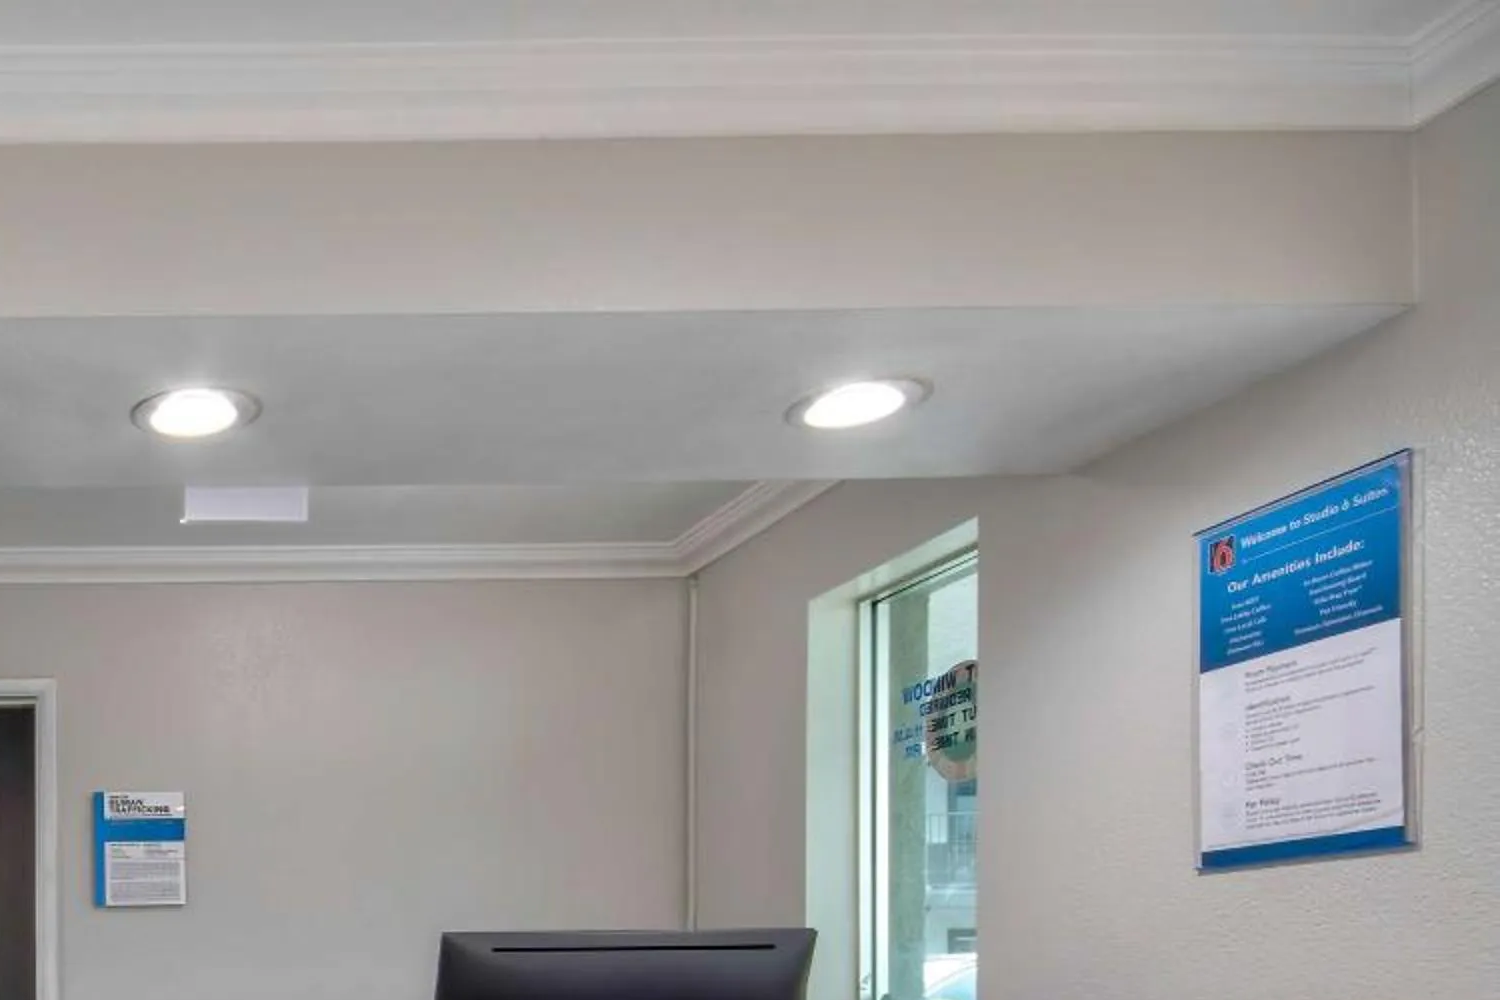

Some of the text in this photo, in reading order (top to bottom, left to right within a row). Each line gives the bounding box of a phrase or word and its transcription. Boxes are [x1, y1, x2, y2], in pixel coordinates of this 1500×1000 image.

[1240, 526, 1287, 548] Welcome
[1289, 519, 1301, 530] to
[1303, 503, 1339, 525] Studio
[1353, 486, 1389, 506] Suites
[1227, 578, 1249, 593] Our
[1251, 557, 1311, 585] Amenities
[1315, 538, 1365, 565] Include:
[109, 805, 171, 813] TRAFFICKING
